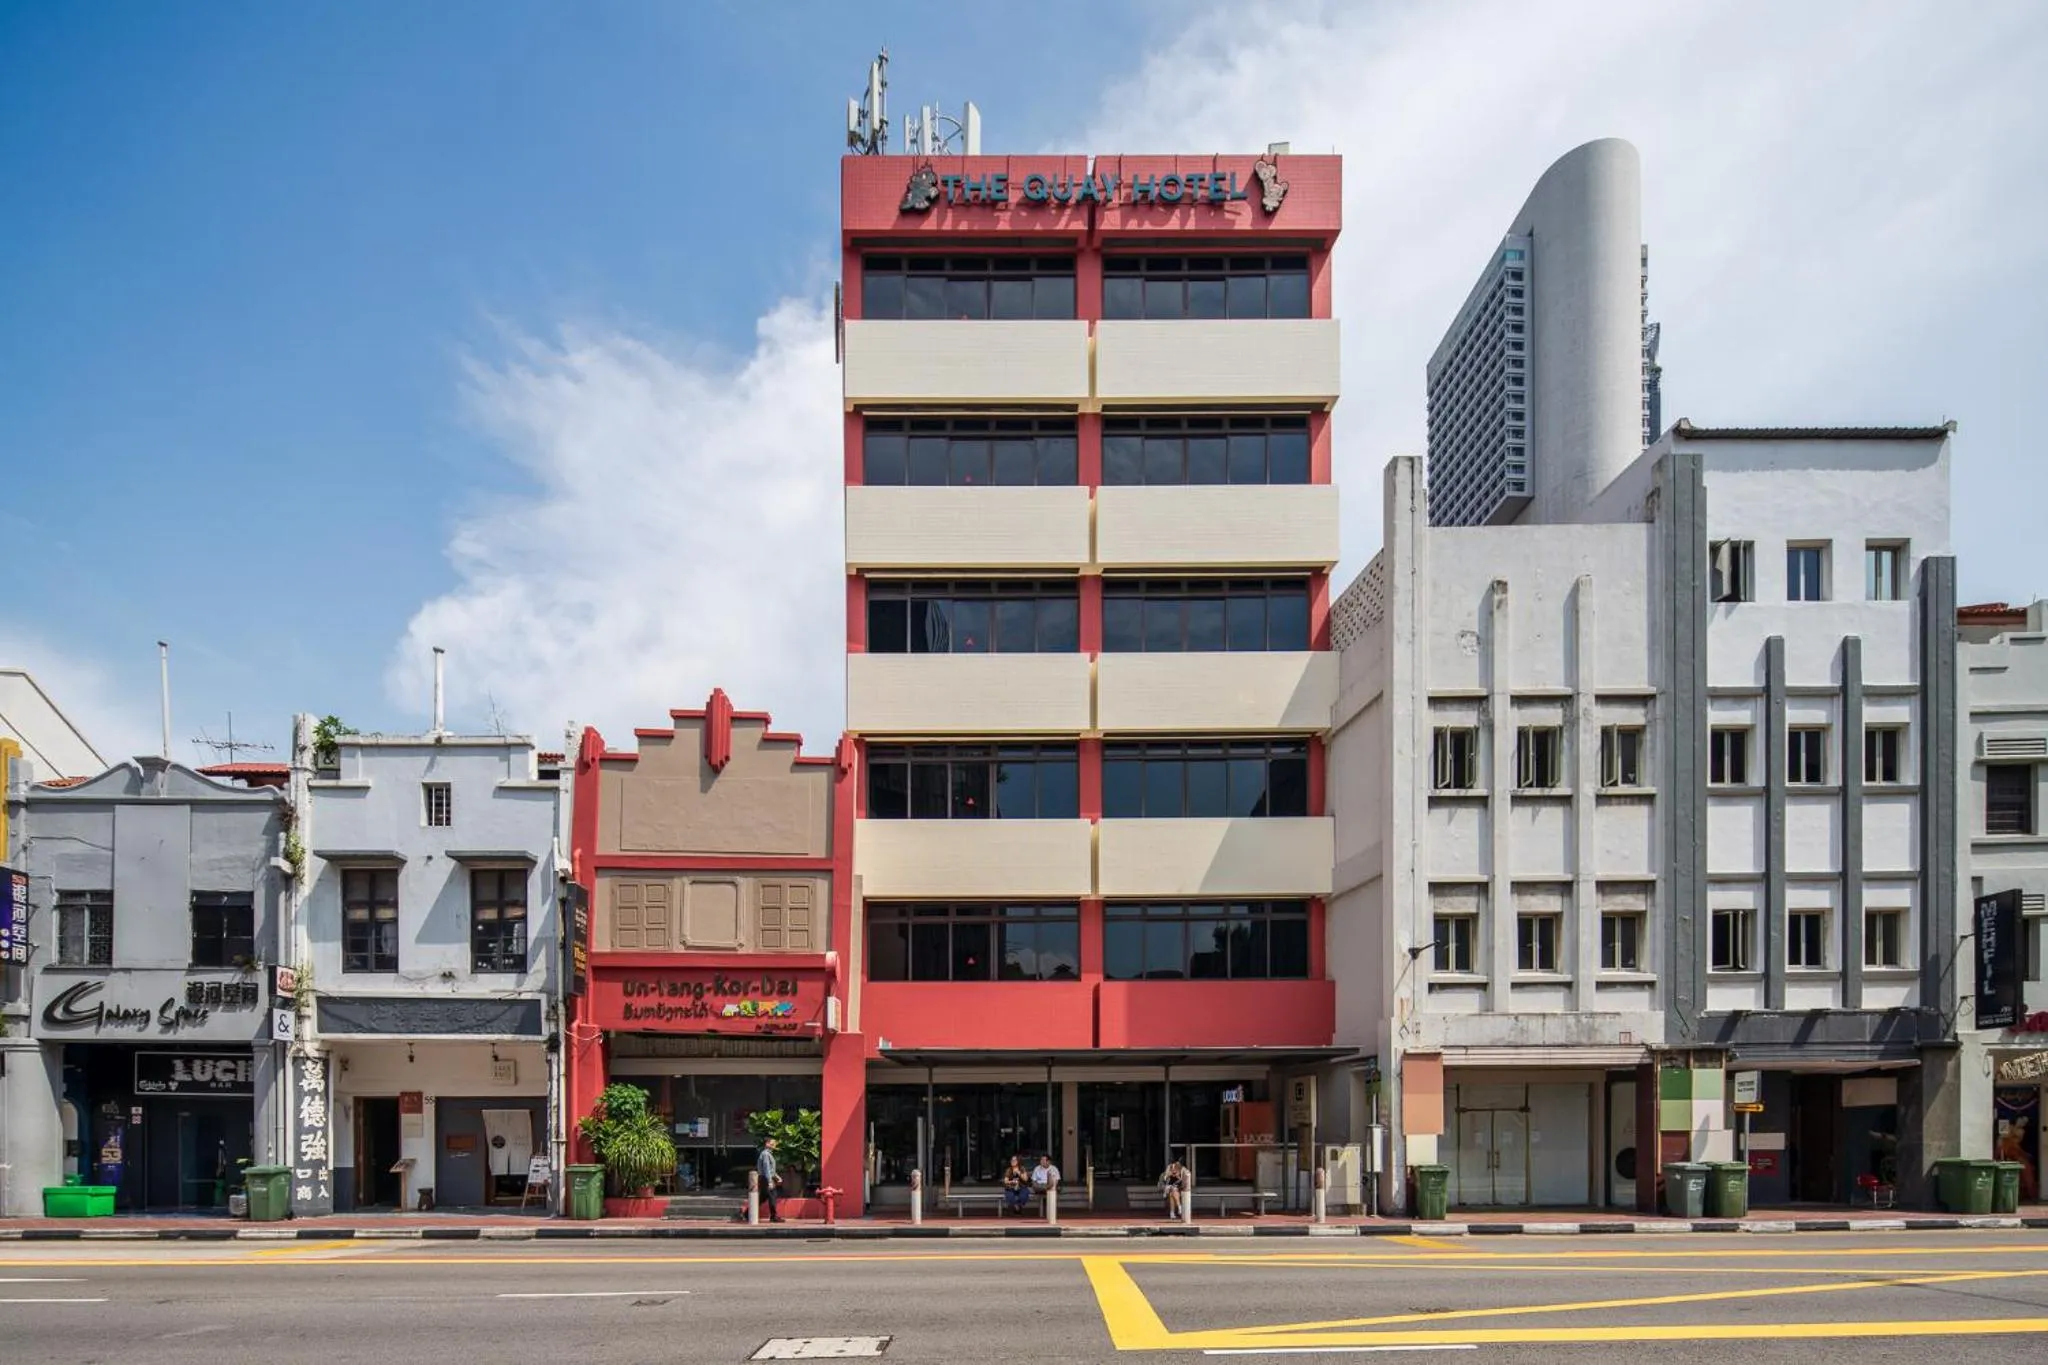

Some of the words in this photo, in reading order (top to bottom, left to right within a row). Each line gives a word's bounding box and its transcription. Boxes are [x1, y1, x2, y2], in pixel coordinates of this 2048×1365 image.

[940, 173, 1009, 204] THE
[1022, 173, 1121, 205] QUAY
[1131, 172, 1249, 206] HOTEL
[1980, 899, 1998, 996] MEHFIL
[42, 981, 151, 1034] Galaxy
[158, 997, 210, 1028] Space
[277, 1013, 290, 1034] &
[209, 1081, 233, 1089] BAR
